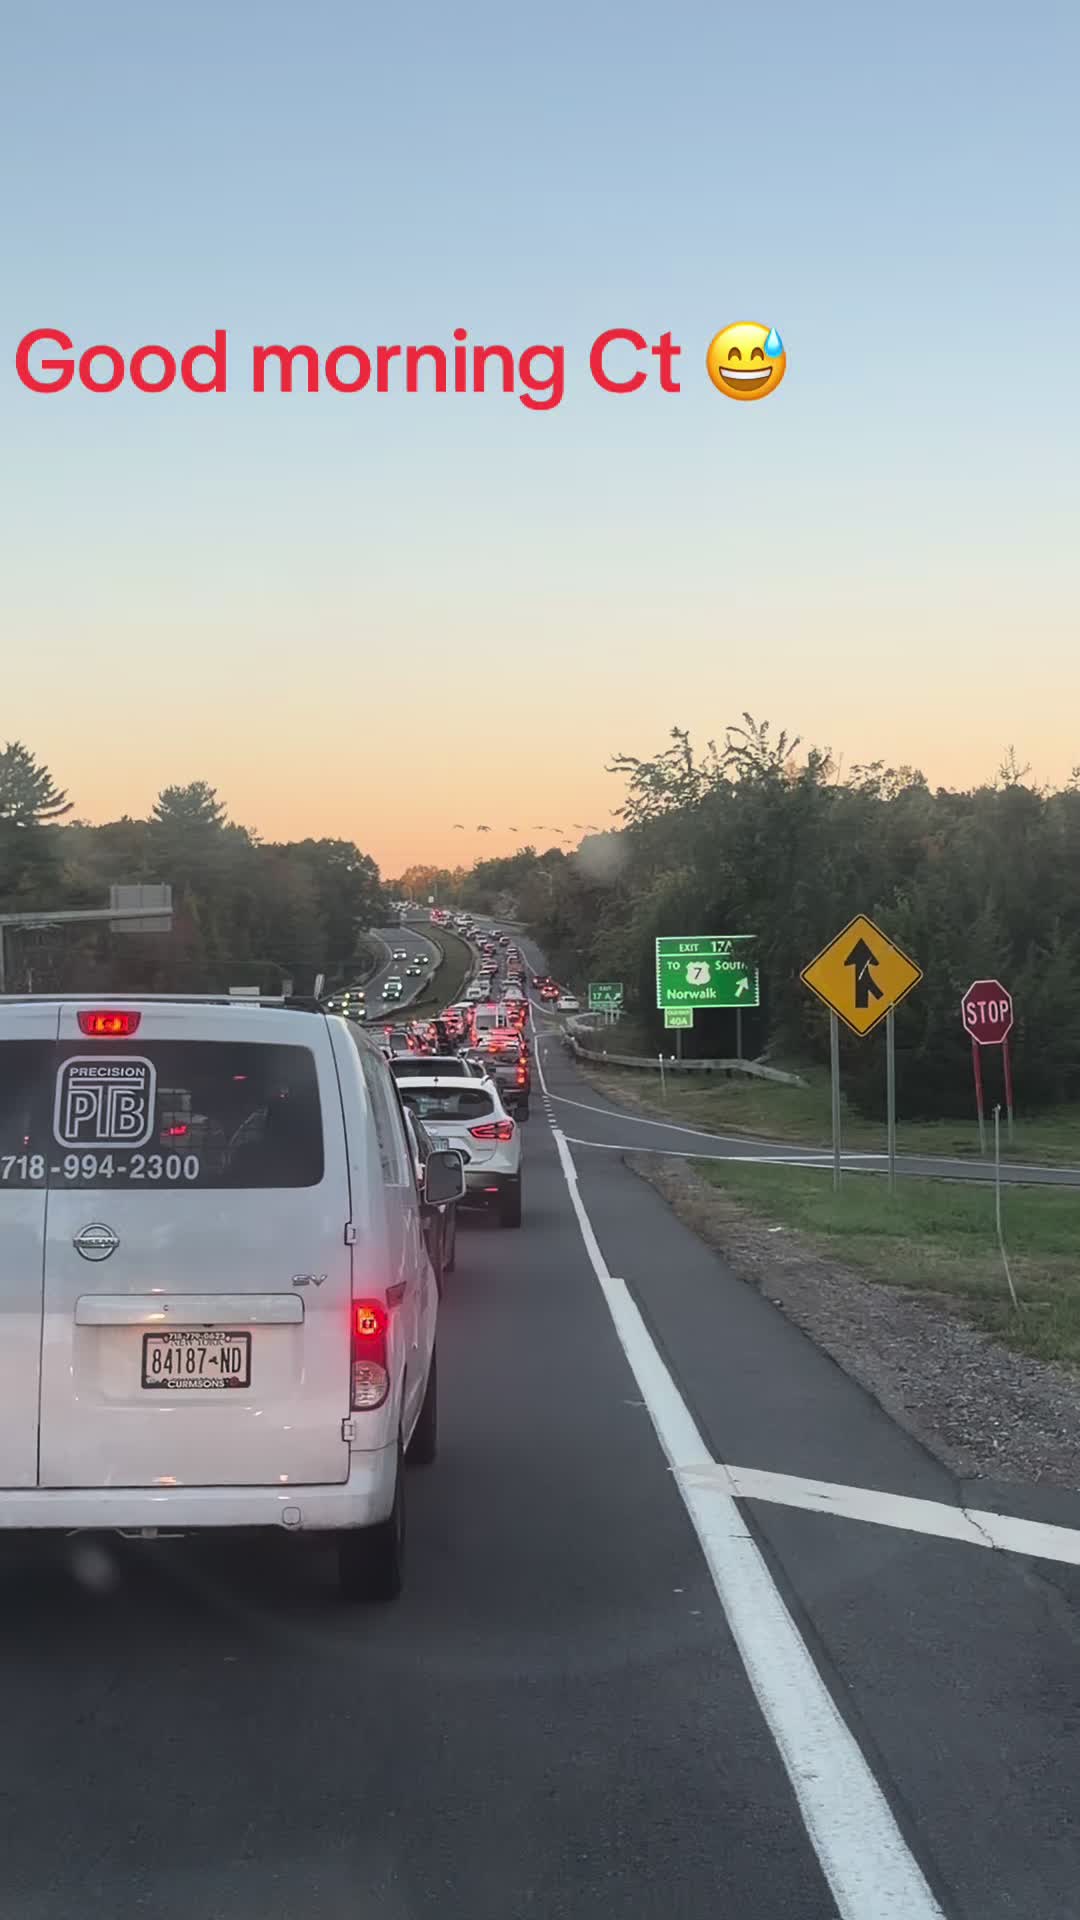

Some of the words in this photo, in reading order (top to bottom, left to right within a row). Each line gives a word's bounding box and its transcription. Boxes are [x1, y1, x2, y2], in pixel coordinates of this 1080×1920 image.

[679, 943, 699, 953] EXIT
[667, 961, 680, 971] TO
[693, 967, 703, 980] 7
[667, 987, 717, 1000] Norwalk
[966, 1000, 1009, 1025] STOP
[69, 1067, 146, 1077] PRECISION
[0, 1154, 200, 1180] 718-994-2300
